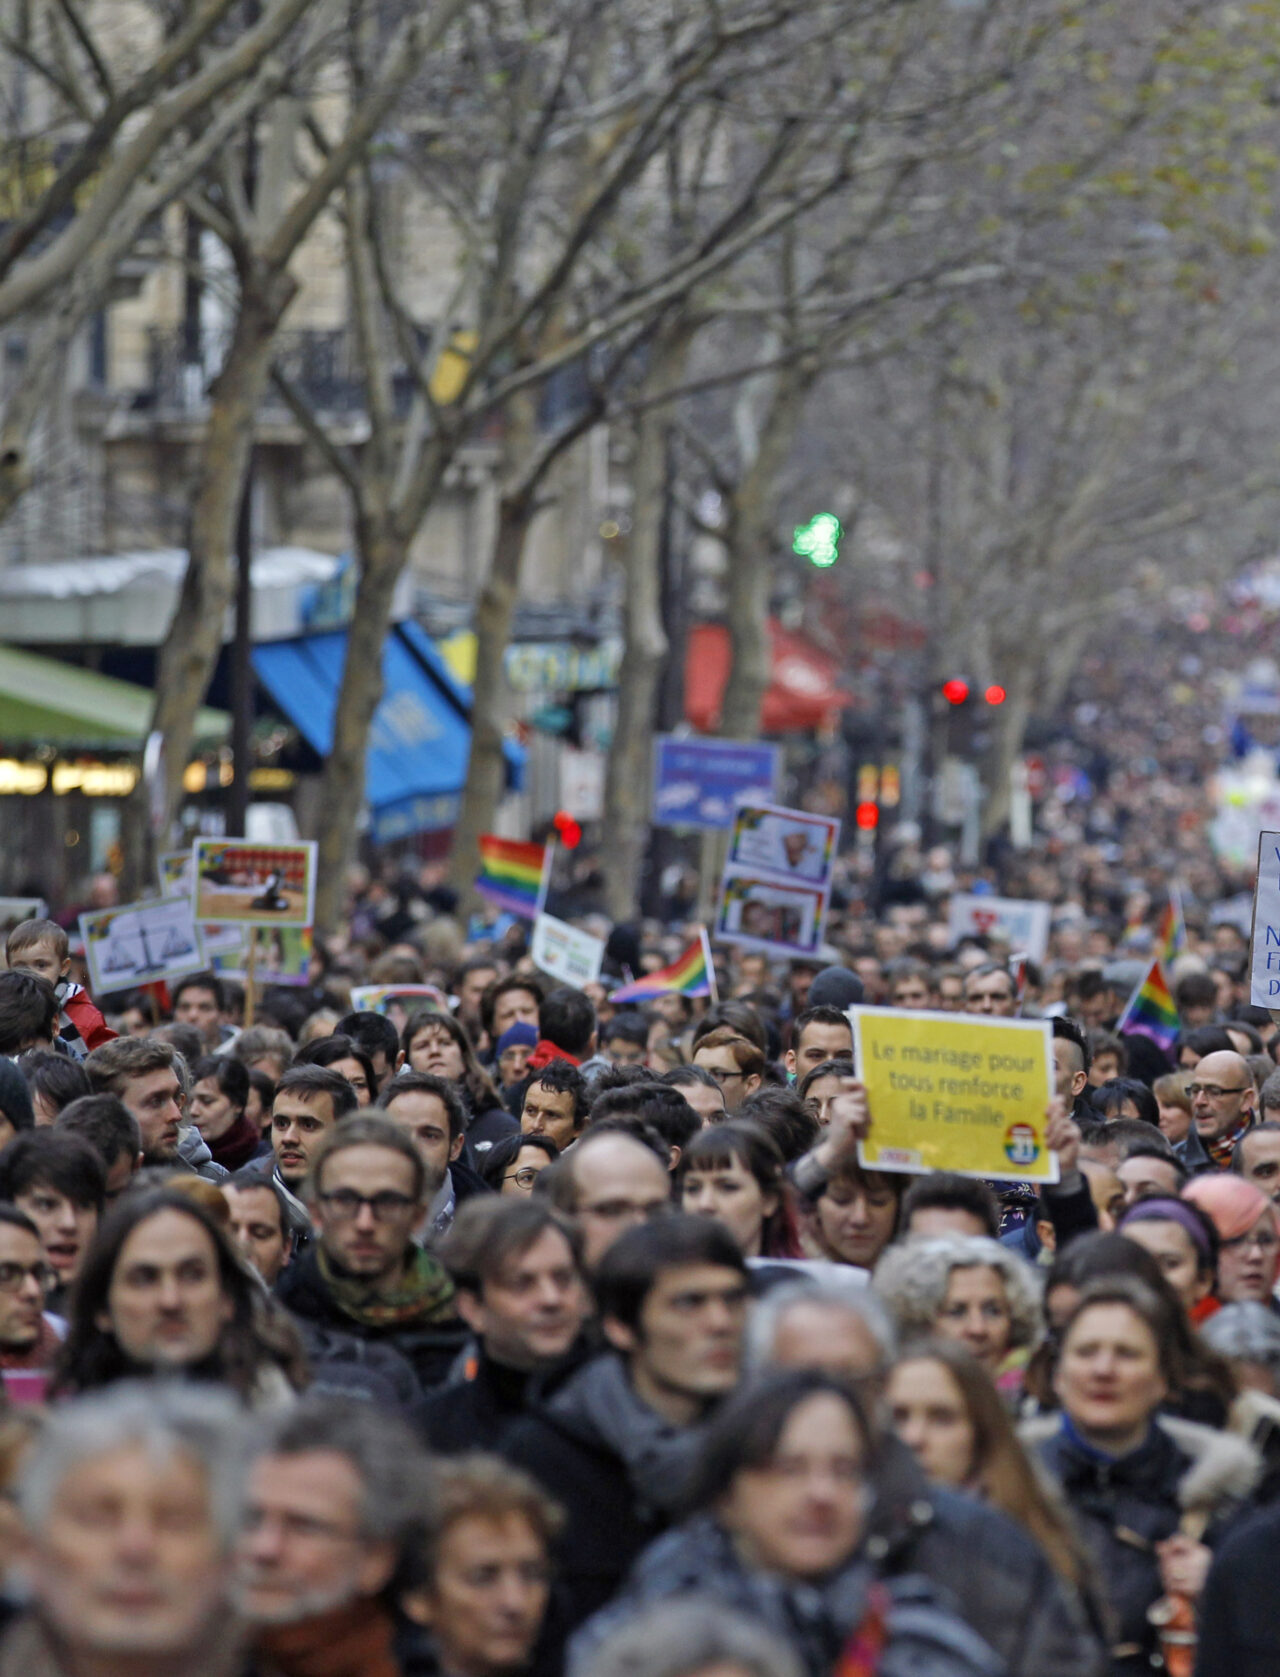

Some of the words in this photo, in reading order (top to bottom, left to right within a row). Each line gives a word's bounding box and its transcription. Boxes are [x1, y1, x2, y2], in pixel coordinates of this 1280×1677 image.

[873, 1040, 894, 1060] Le
[901, 1045, 983, 1070] mariage
[988, 1054, 1035, 1074] pour
[889, 1071, 933, 1093] tous
[938, 1076, 1025, 1100] renforce
[909, 1098, 926, 1121] la
[932, 1101, 1005, 1128] Famille
